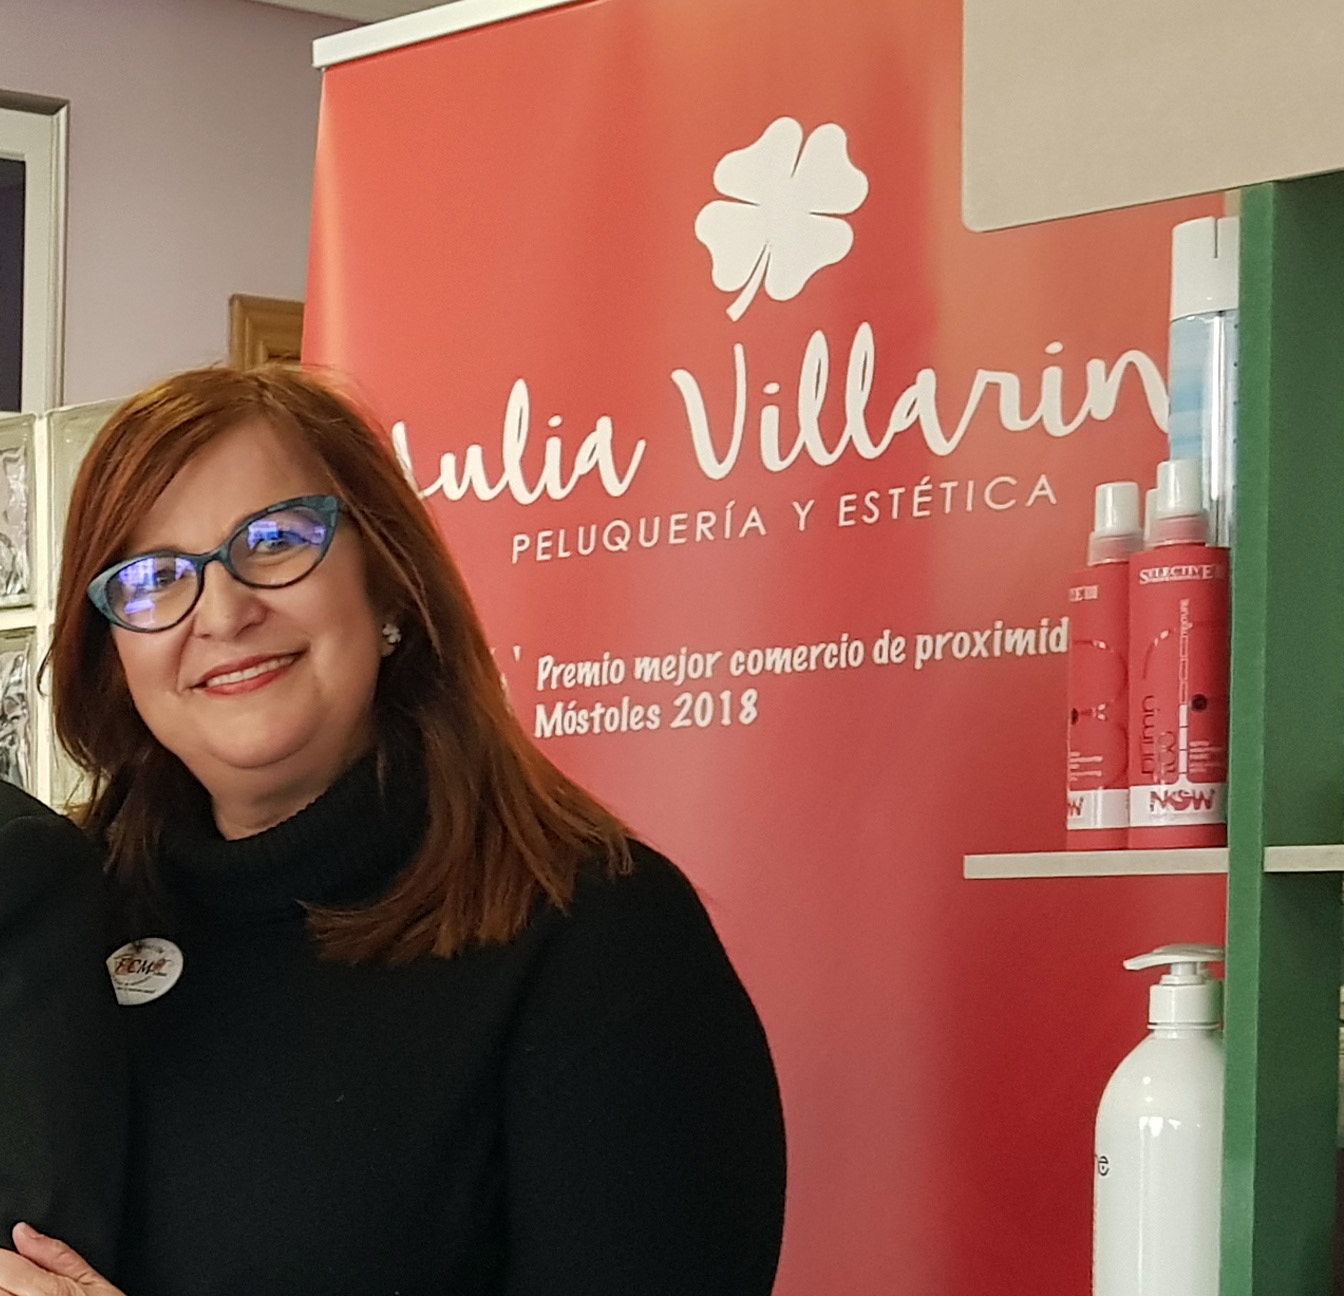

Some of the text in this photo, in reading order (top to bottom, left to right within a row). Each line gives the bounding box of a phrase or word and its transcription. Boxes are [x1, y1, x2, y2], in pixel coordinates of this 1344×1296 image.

[511, 474, 1058, 564] PELUQUERÍA Y ESTÉTICA
[536, 647, 623, 691] Premio
[634, 643, 721, 686] mejor
[729, 634, 863, 677] comercio
[872, 628, 906, 666] de
[534, 689, 759, 738] Móstoles 2018
